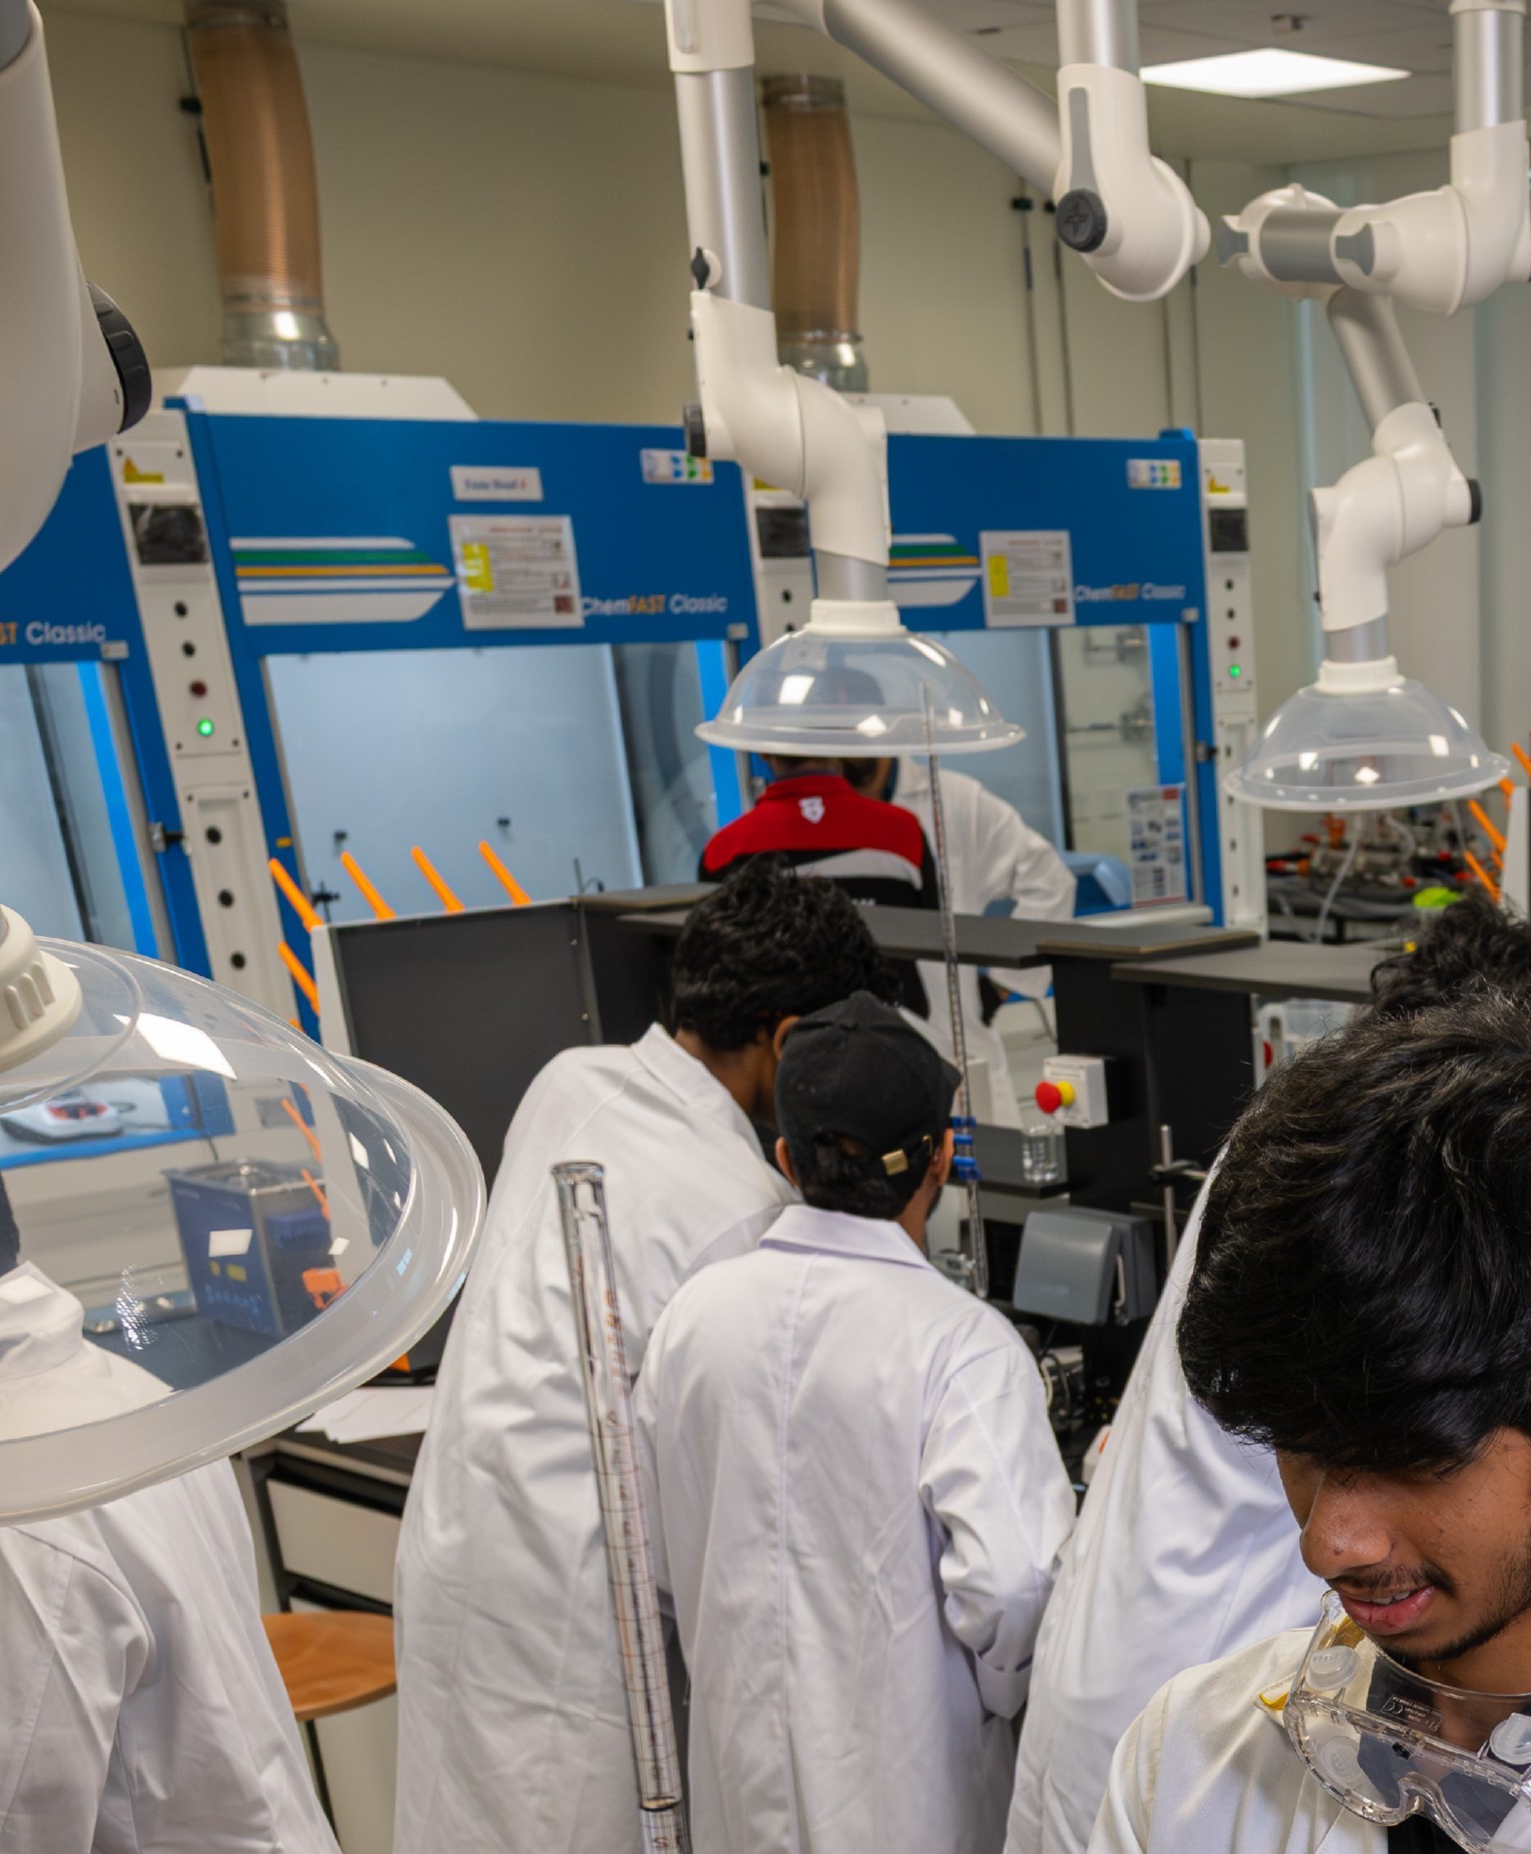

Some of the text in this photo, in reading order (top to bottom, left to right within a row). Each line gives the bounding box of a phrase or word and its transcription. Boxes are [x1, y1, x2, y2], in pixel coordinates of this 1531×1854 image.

[581, 593, 728, 616] ChemFAST Classic
[25, 620, 107, 646] Classic
